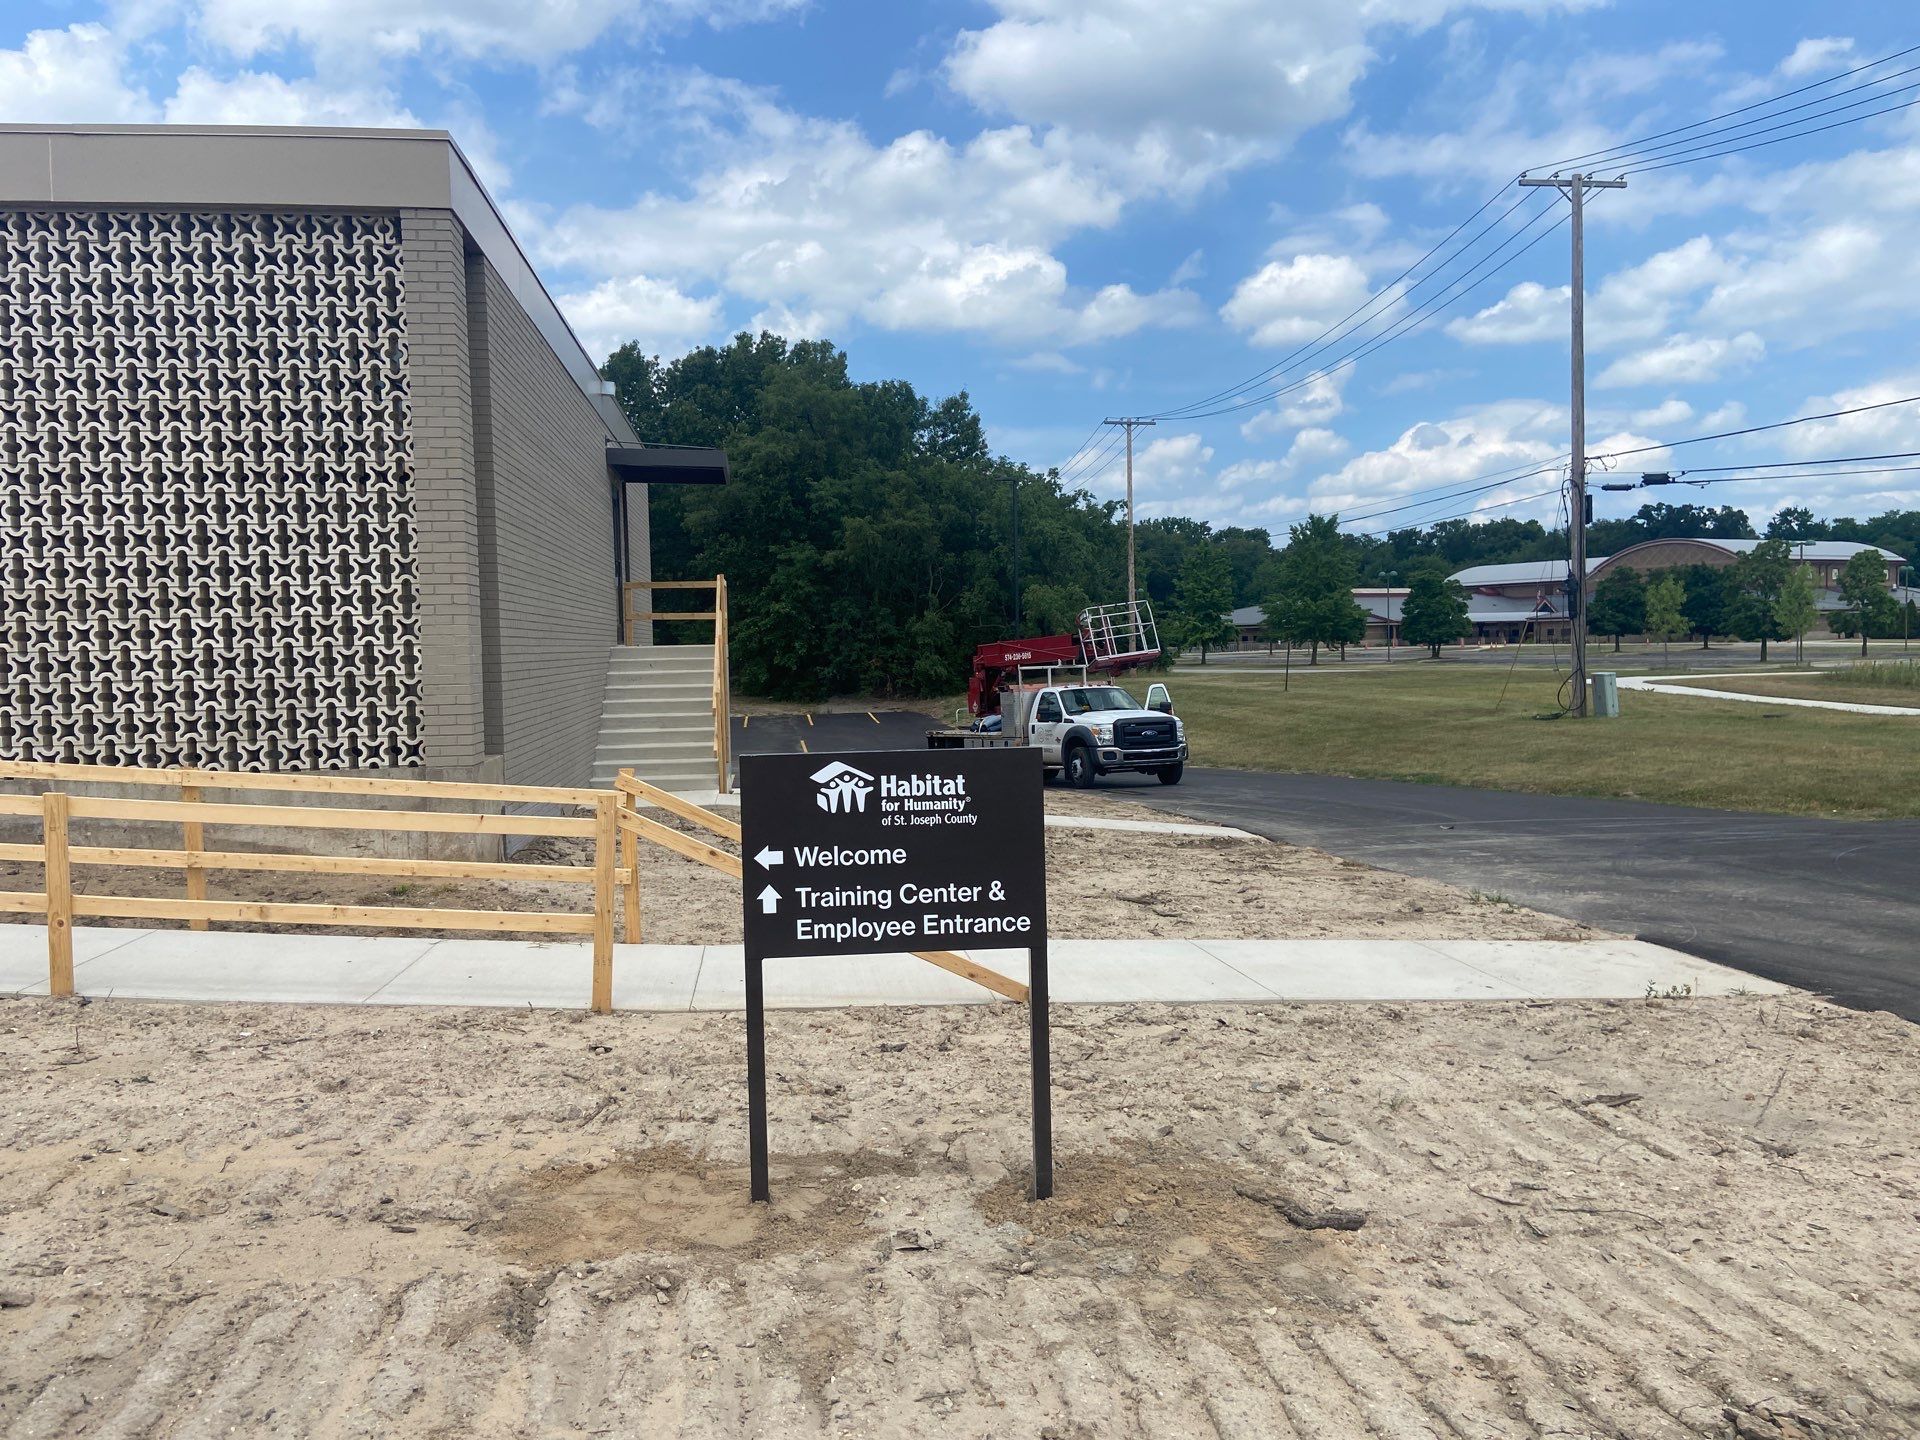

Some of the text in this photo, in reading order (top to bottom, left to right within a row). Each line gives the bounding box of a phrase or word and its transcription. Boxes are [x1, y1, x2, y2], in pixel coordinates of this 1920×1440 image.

[880, 774, 966, 797] Habitat
[881, 799, 900, 811] for
[881, 813, 978, 826] of St. Joseph County
[794, 845, 907, 868] Welcome
[795, 881, 1007, 911] Training Center &
[797, 915, 1032, 943] Employee Entrance
